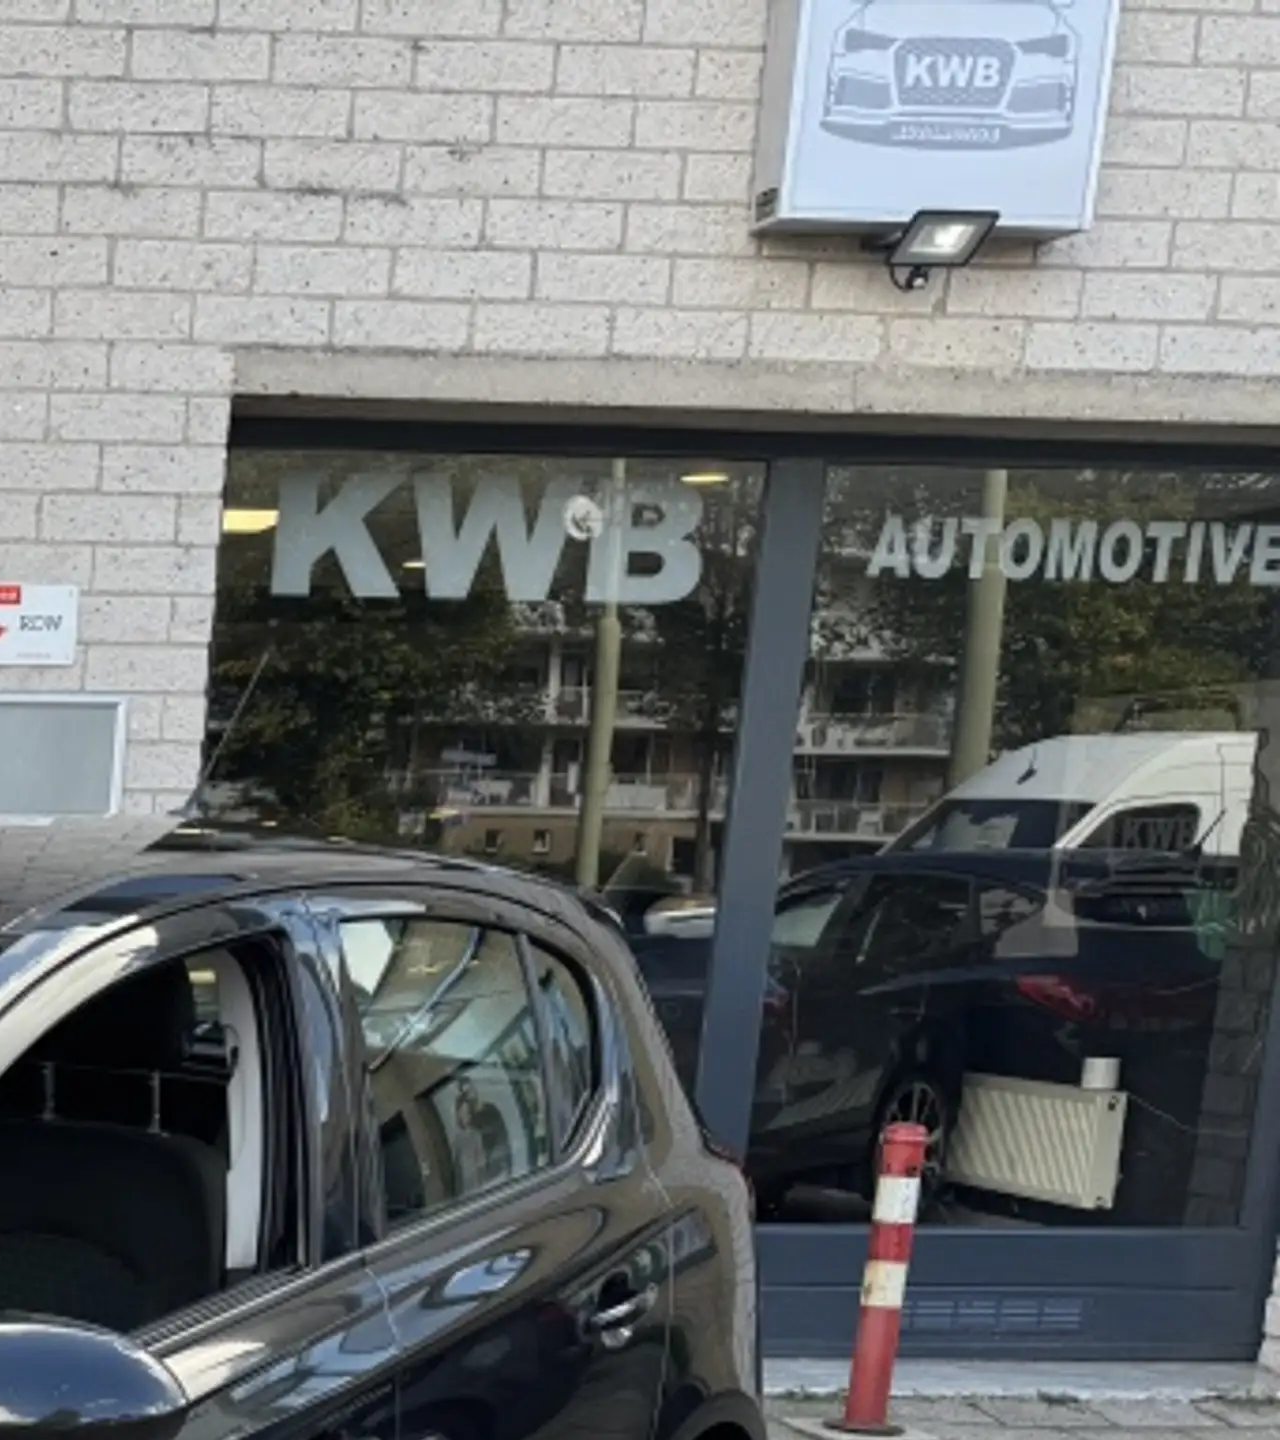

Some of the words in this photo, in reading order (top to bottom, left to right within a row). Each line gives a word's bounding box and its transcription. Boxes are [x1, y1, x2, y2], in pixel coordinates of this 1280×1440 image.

[904, 54, 1003, 89] KWB
[270, 471, 704, 605] KWB
[865, 513, 1280, 586] AUTOMOTIVE
